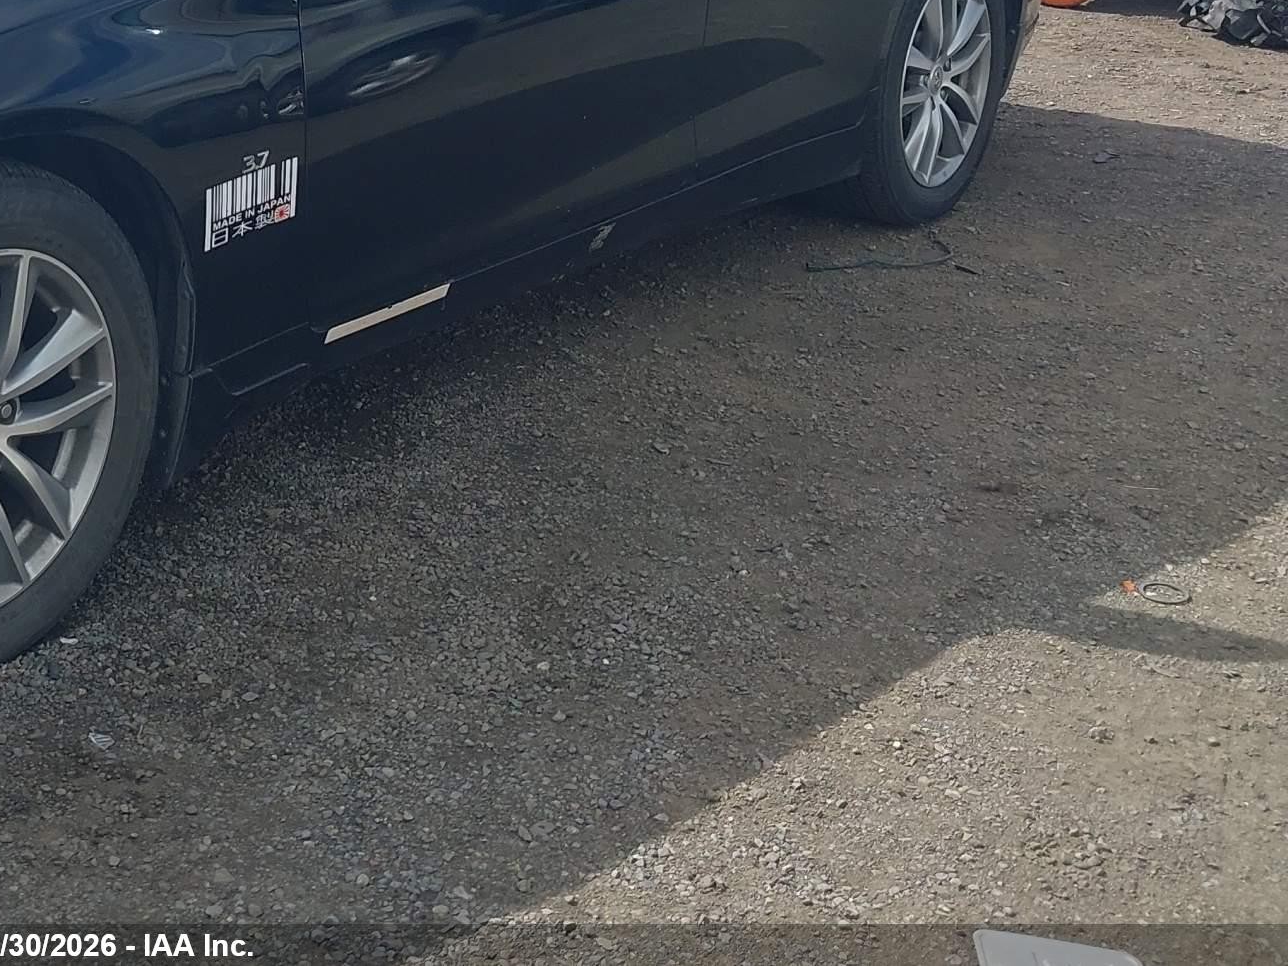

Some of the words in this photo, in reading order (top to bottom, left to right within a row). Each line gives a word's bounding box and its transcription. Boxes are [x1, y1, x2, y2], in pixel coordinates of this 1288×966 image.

[213, 213, 242, 231] MADE
[245, 208, 255, 219] IN
[257, 194, 291, 213] JAPAN
